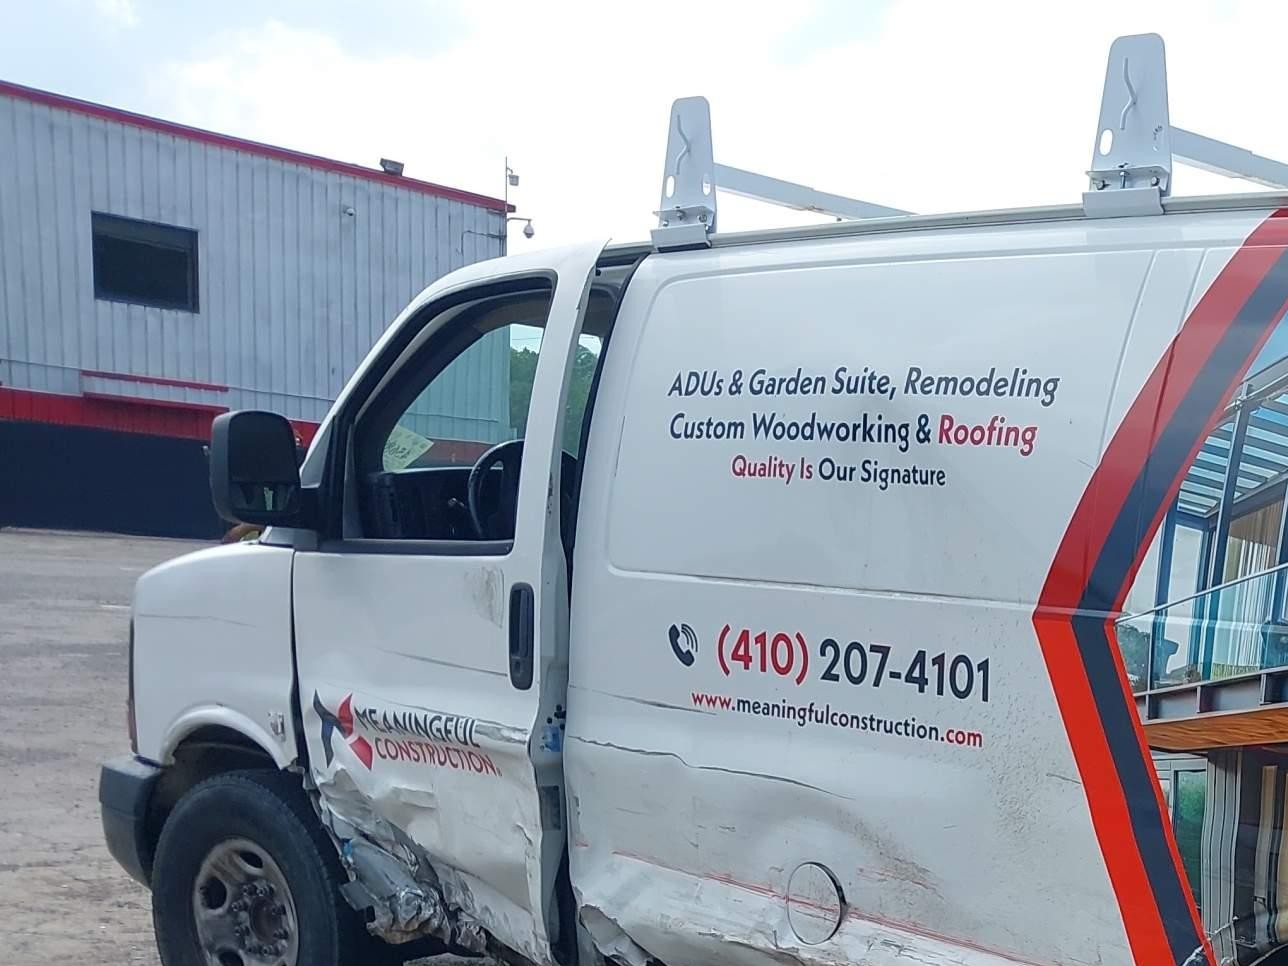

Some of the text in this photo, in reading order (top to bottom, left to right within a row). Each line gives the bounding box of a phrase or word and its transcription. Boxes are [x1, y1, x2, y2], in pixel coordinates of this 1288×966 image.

[667, 366, 1060, 407] ADUs & Garden Suite, Remodeling
[669, 412, 1038, 457] Custom Woodworking & Roofing
[731, 454, 946, 491] Quality Is Our Signature
[717, 623, 991, 703] (410) 207-4101
[353, 706, 481, 749] MEANINGFUL
[691, 690, 984, 749] www.meaningfulconstruction.com
[374, 737, 498, 776] CONSTRUCTION
